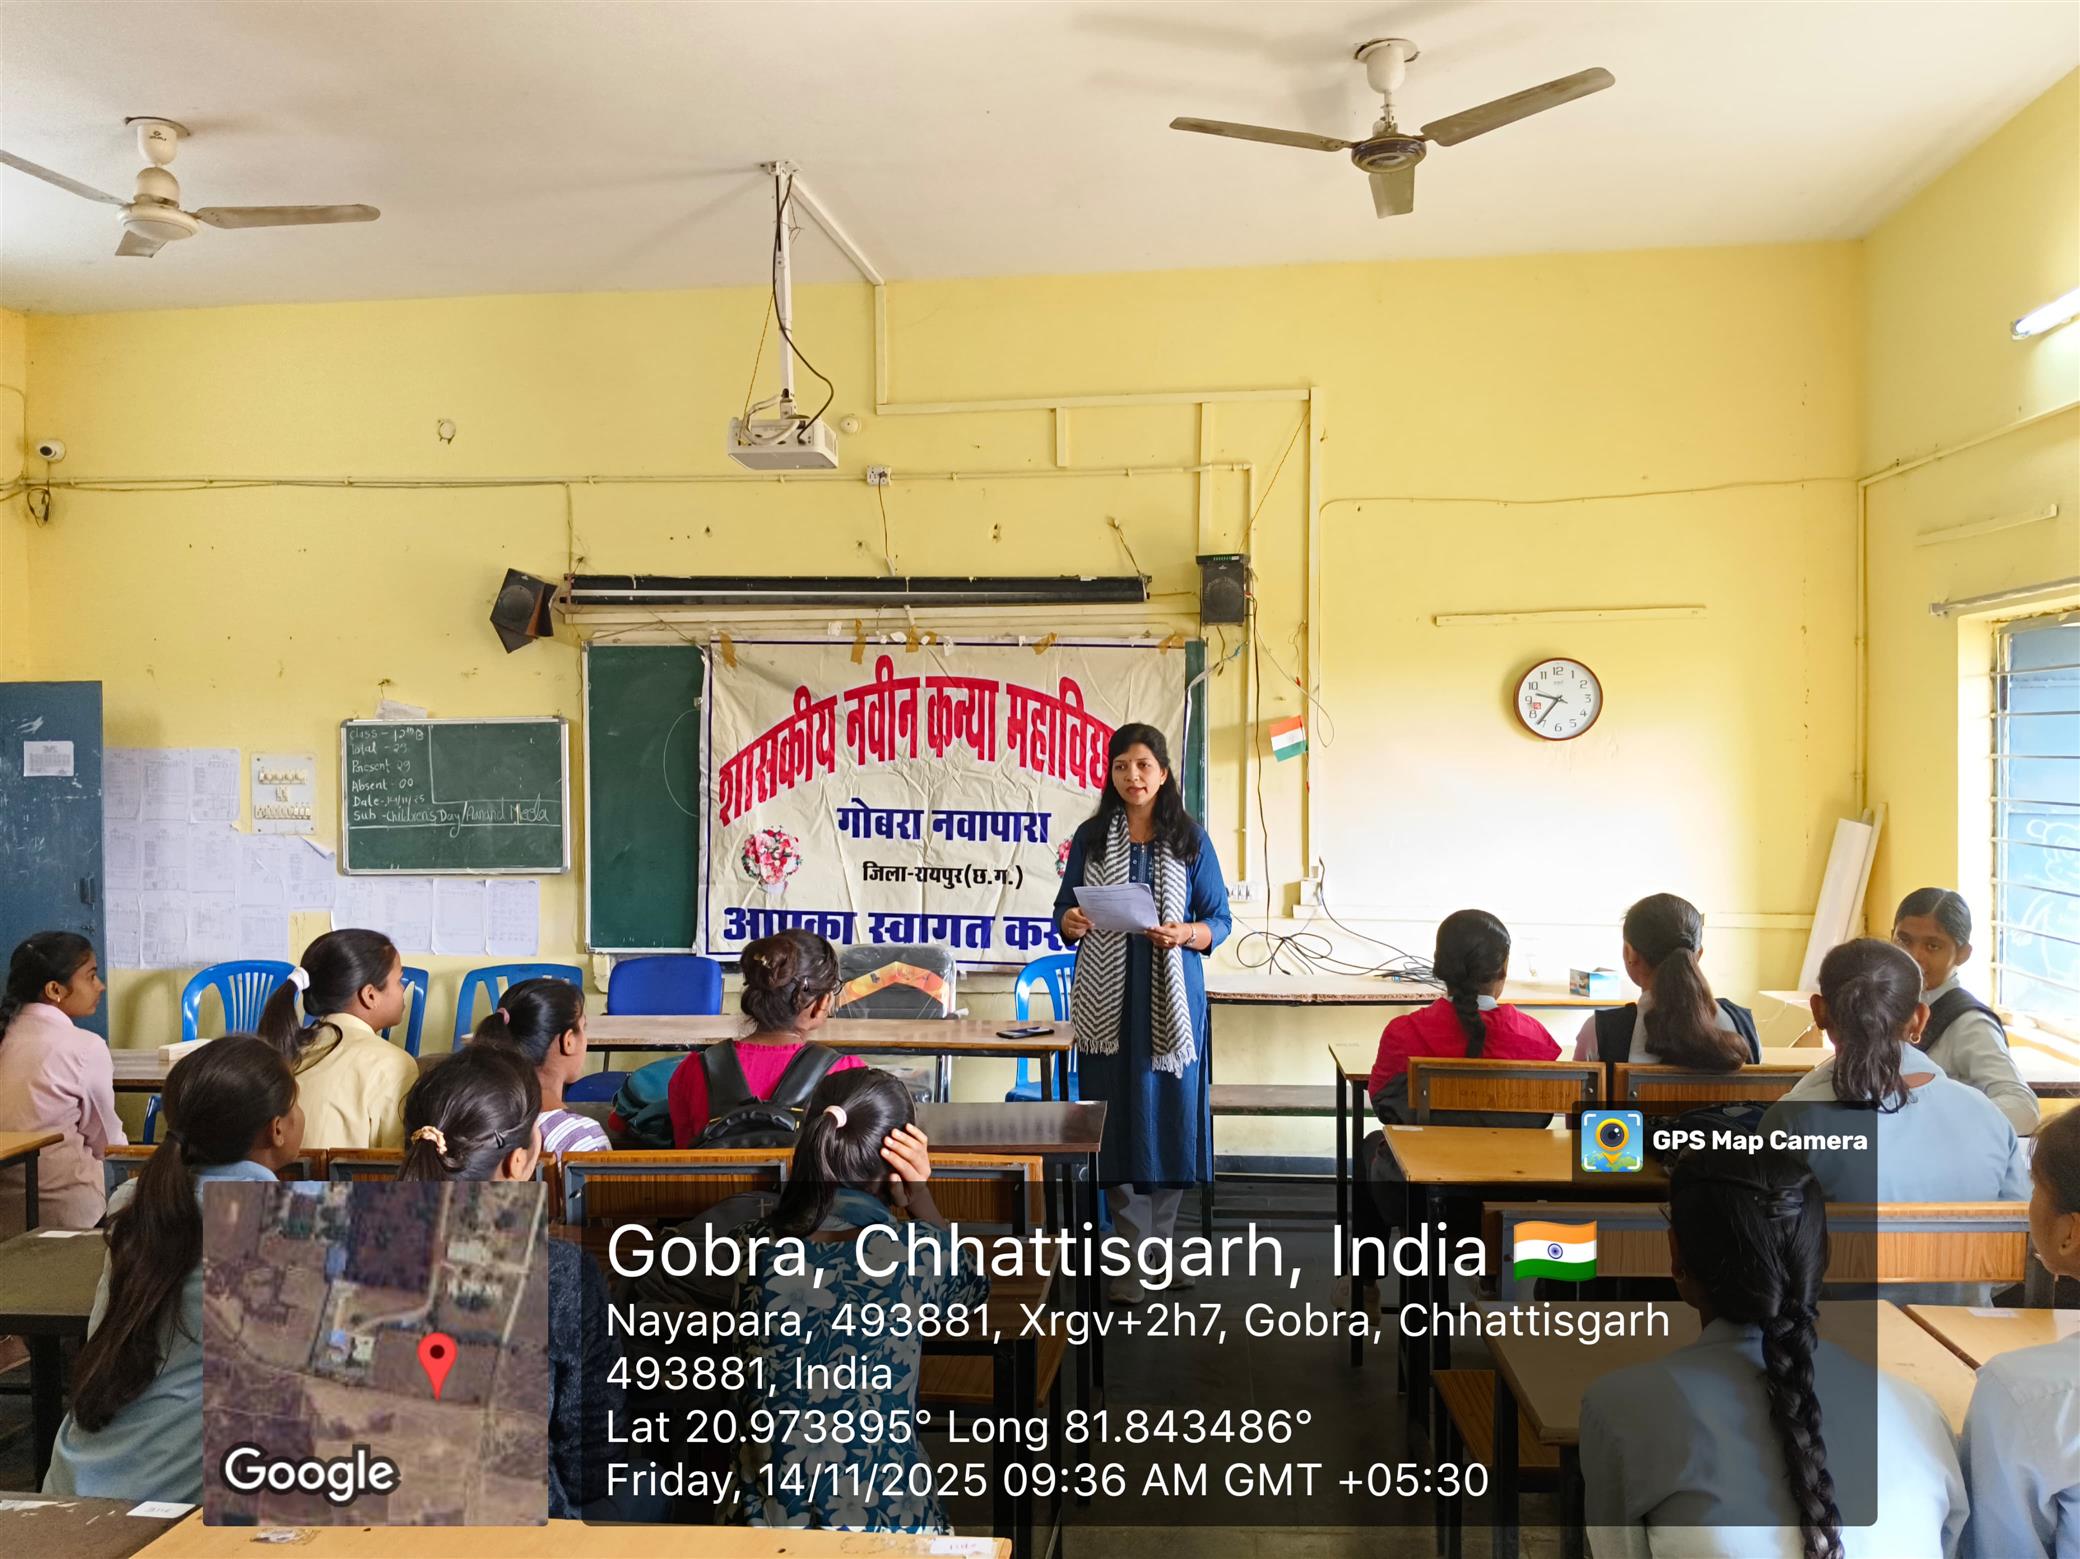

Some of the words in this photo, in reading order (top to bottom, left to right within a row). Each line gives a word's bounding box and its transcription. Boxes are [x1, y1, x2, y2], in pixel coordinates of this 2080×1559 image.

[1540, 671, 1547, 680] 11
[1552, 666, 1564, 676] 12
[1571, 669, 1575, 679] 1
[1528, 681, 1539, 691] 10
[1579, 680, 1588, 689] 2
[1525, 695, 1533, 705] 9
[1585, 694, 1592, 704] 3
[1528, 710, 1537, 719] 8
[1579, 709, 1587, 718] 4
[1554, 722, 1563, 732] 6
[1569, 718, 1577, 728] 5
[719, 685, 838, 827] शासकीय
[843, 654, 921, 765] नवीन
[925, 675, 1000, 762] कन्या
[352, 758, 390, 774] Present
[351, 778, 388, 793] Absent
[399, 778, 414, 790] 00
[353, 808, 377, 821] Sub
[837, 797, 924, 840] गोबरा
[931, 811, 1053, 844] नवापारा
[868, 911, 996, 950] स्वागत
